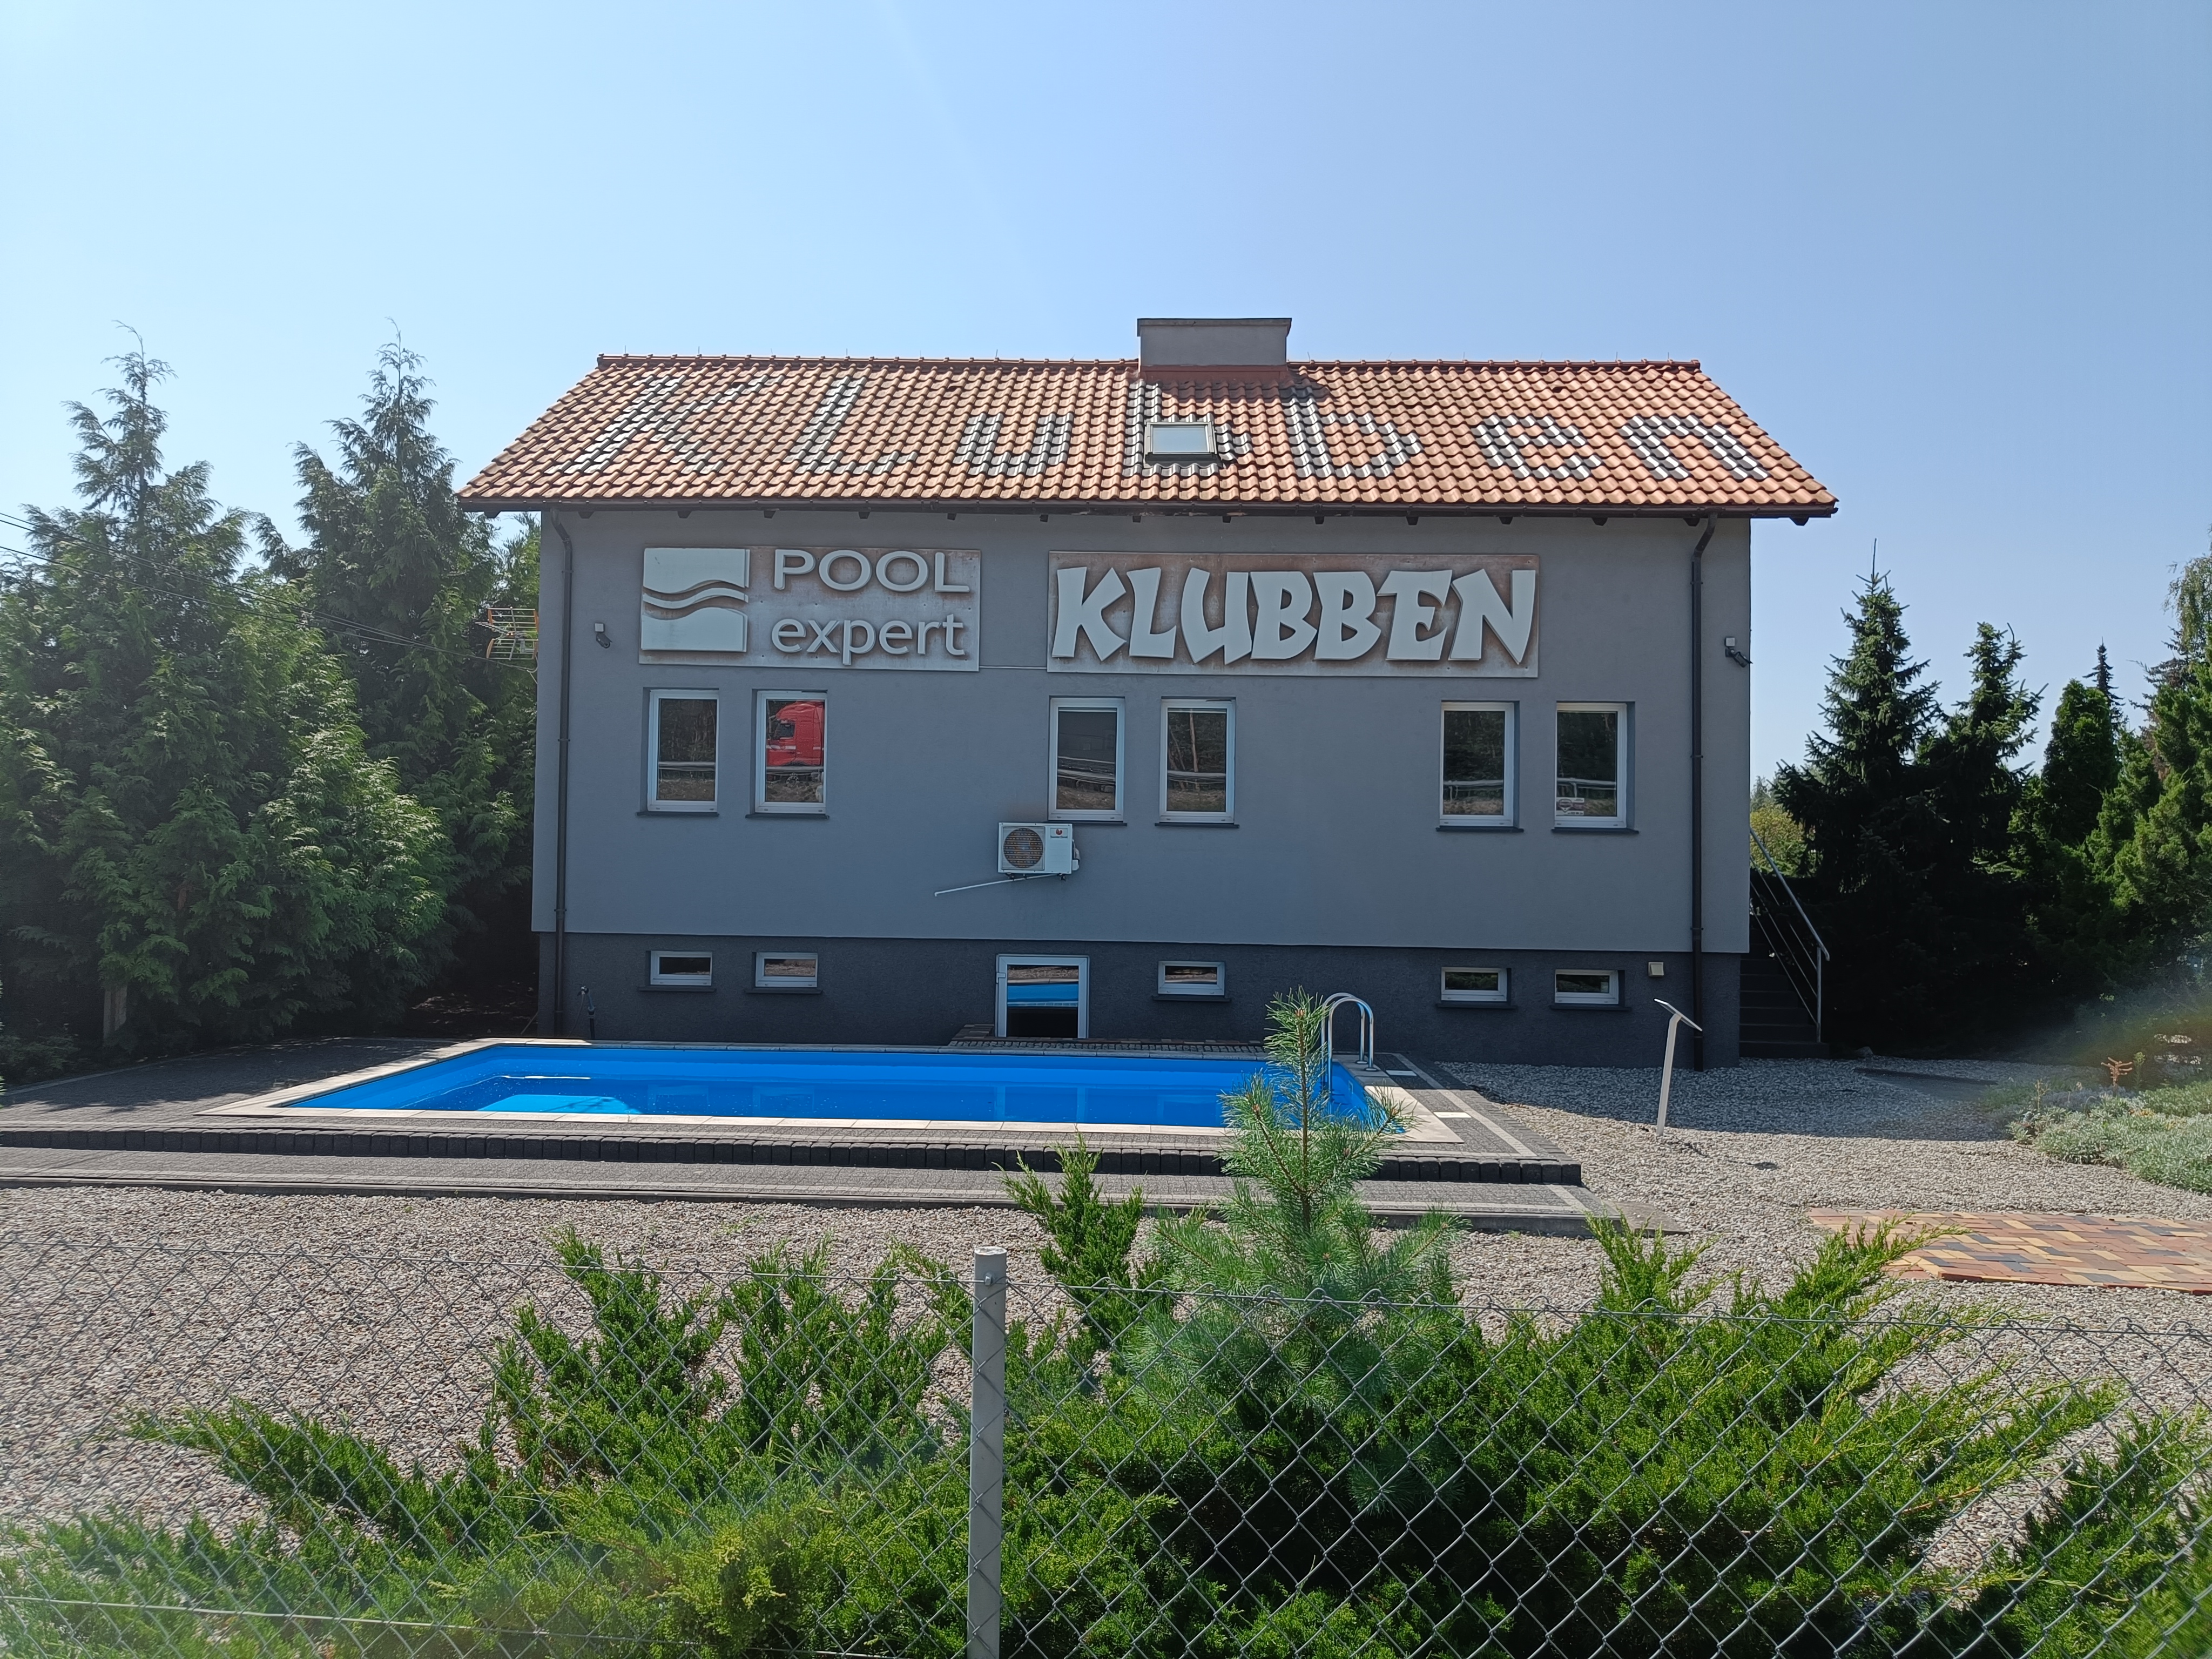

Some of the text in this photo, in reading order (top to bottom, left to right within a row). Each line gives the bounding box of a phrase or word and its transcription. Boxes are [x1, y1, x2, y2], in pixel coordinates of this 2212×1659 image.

[774, 549, 970, 593] POOL
[772, 614, 966, 665] expert
[1051, 567, 1536, 664] KLUBBEN
